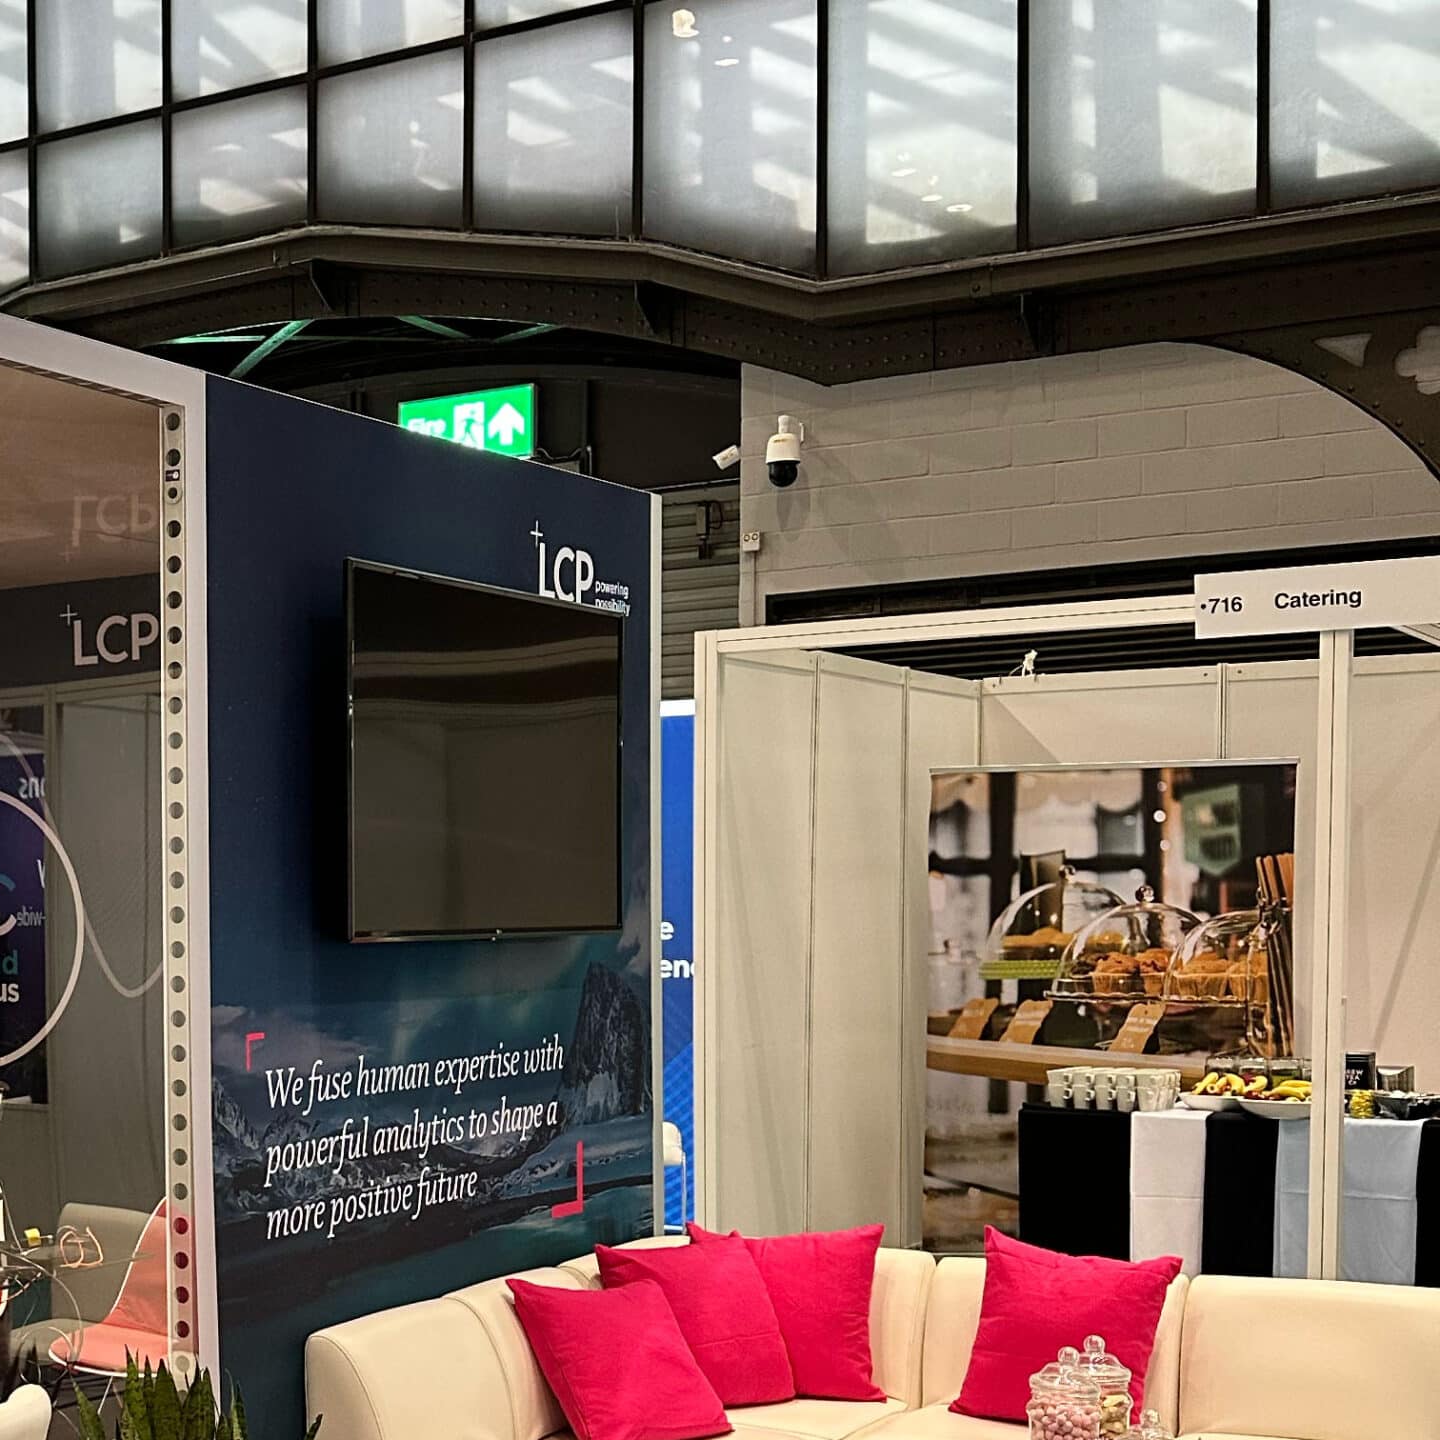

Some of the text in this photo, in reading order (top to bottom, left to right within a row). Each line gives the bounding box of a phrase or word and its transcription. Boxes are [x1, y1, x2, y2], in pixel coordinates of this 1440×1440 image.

[539, 542, 594, 604] LCP
[595, 580, 629, 600] powering
[1208, 589, 1362, 614] 716 Catering
[73, 612, 160, 667] LCP
[265, 1033, 565, 1116] We fuse human expertise with
[264, 1096, 559, 1188] powerful analytics to shape a
[266, 1167, 479, 1240] more positive future
